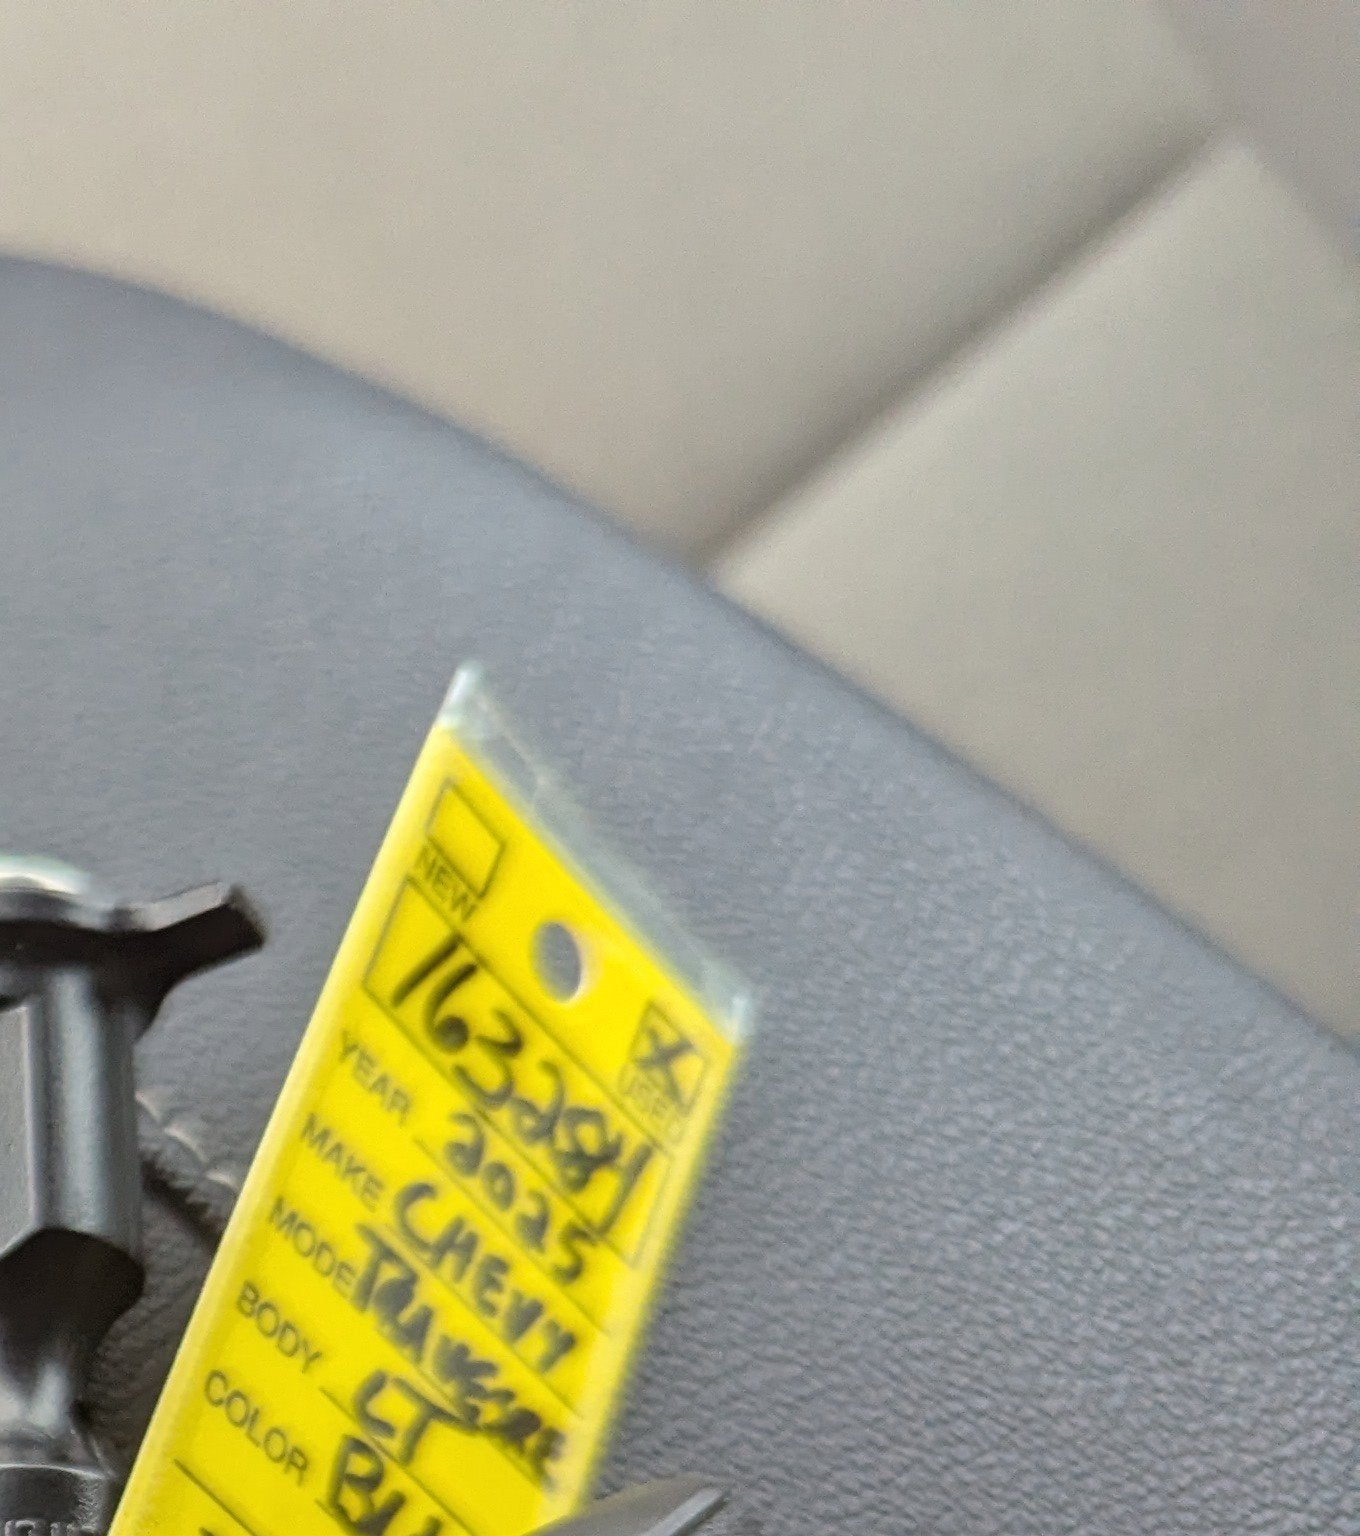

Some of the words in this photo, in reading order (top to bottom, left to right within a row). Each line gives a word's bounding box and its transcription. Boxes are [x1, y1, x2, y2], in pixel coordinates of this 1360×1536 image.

[416, 845, 477, 921] NEW
[341, 1031, 413, 1126] YEAR
[392, 932, 654, 1234] 163284
[300, 1114, 385, 1212] MAKE
[446, 1111, 598, 1285] 2025
[268, 1196, 357, 1302] MODE
[393, 1182, 577, 1375] CHEVY
[237, 1280, 323, 1375] BODY
[204, 1368, 310, 1486] COLOR
[354, 1370, 479, 1467] LT
